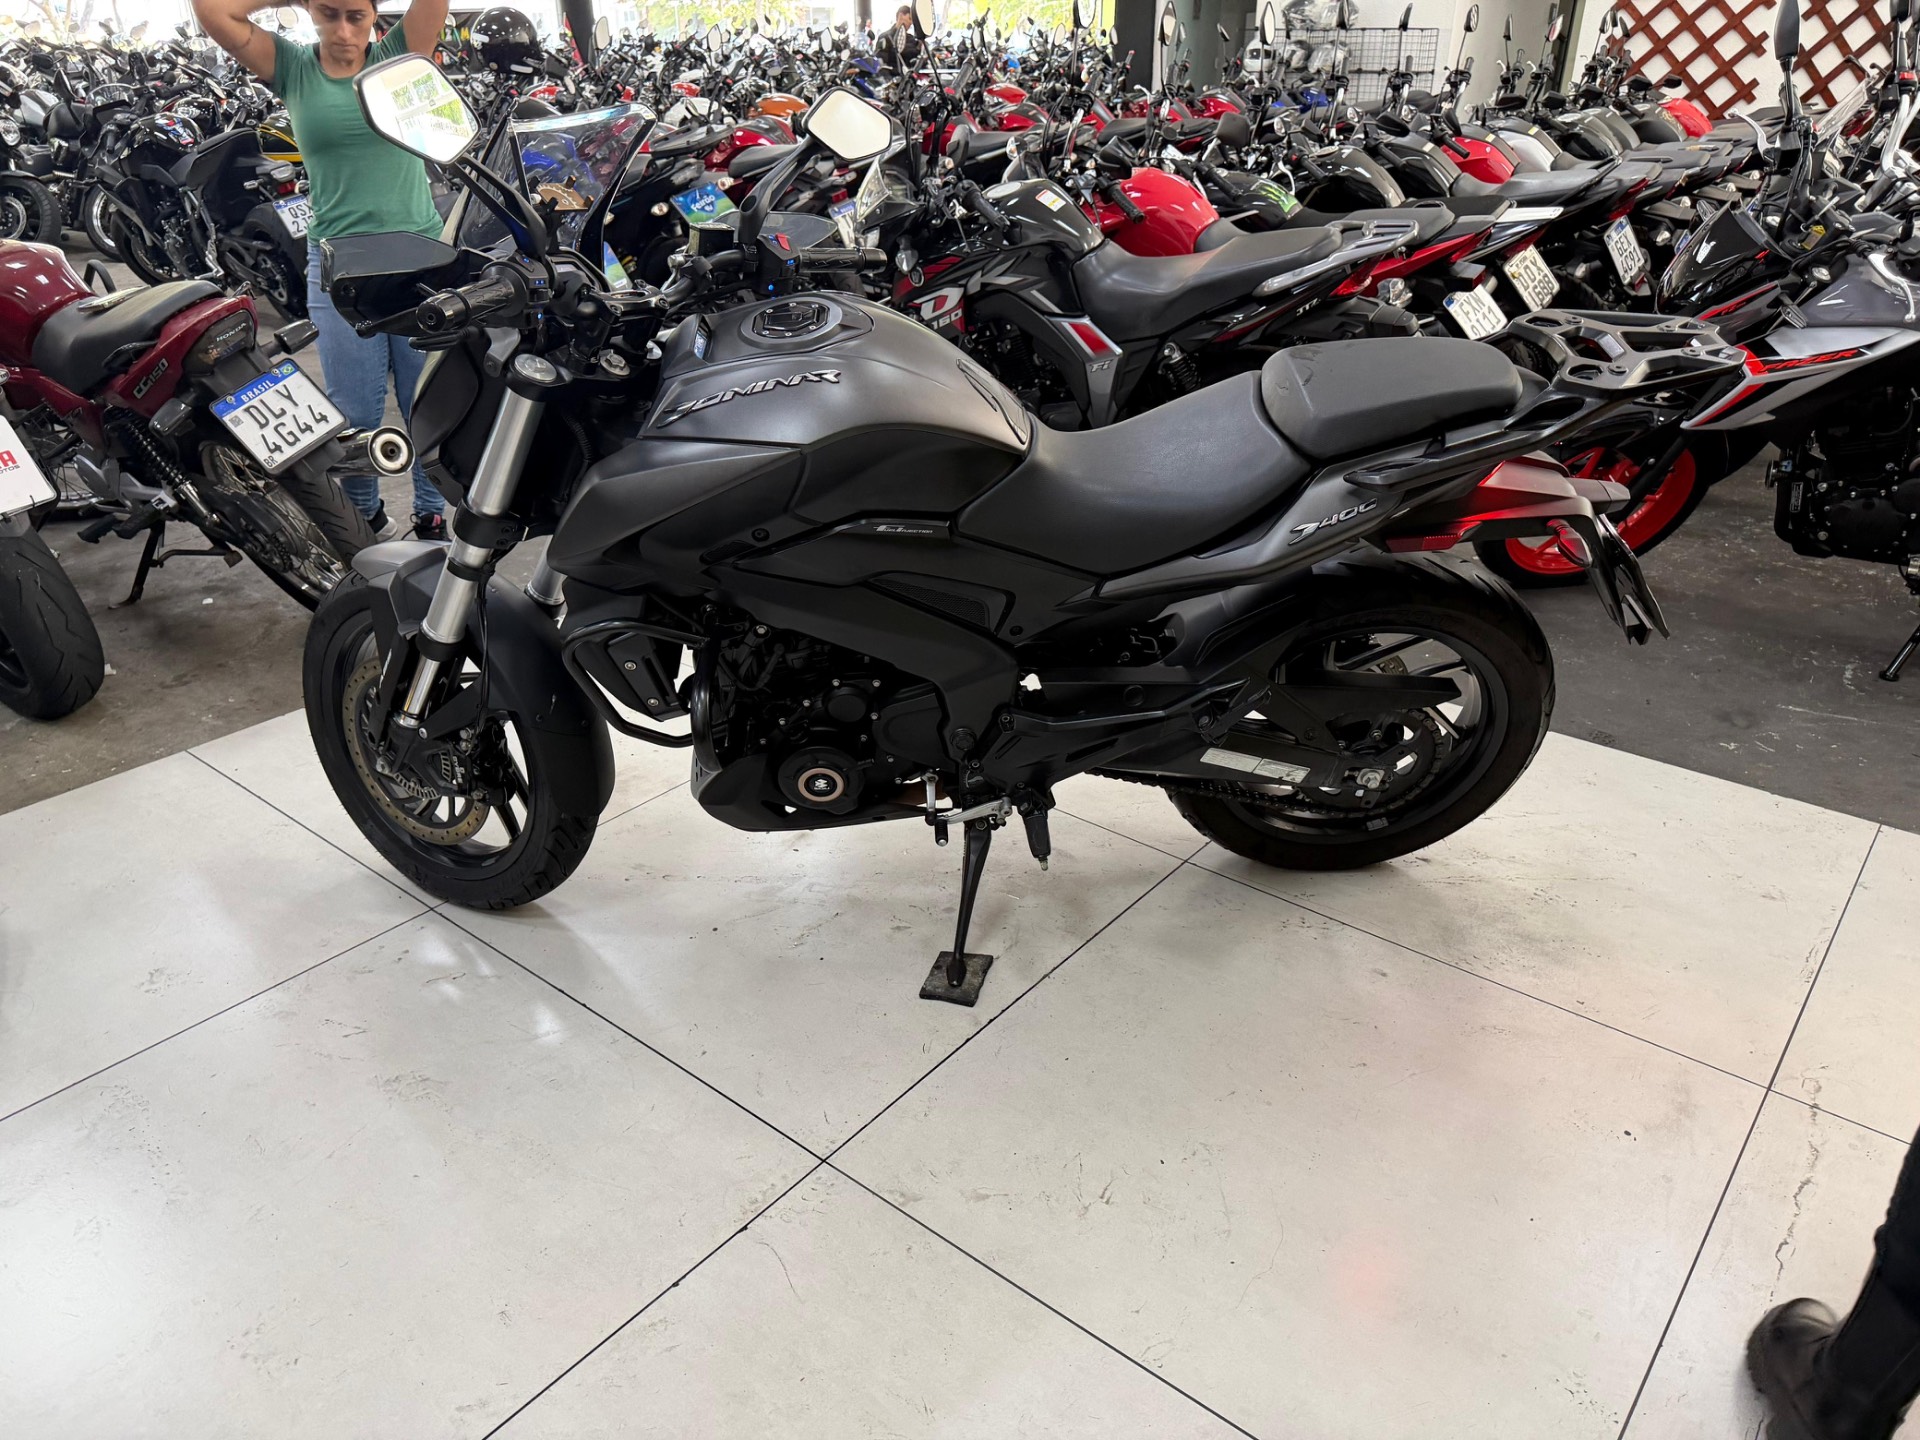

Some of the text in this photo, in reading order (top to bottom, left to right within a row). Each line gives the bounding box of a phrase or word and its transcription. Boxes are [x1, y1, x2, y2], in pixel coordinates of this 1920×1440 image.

[216, 322, 247, 342] HONDA
[931, 308, 963, 331] 160
[133, 358, 168, 400] CG150
[241, 379, 275, 403] BRASIL
[242, 384, 299, 430] DLY
[657, 369, 842, 430] DOMINAR
[260, 404, 330, 455] 4G44
[263, 455, 279, 467] BR
